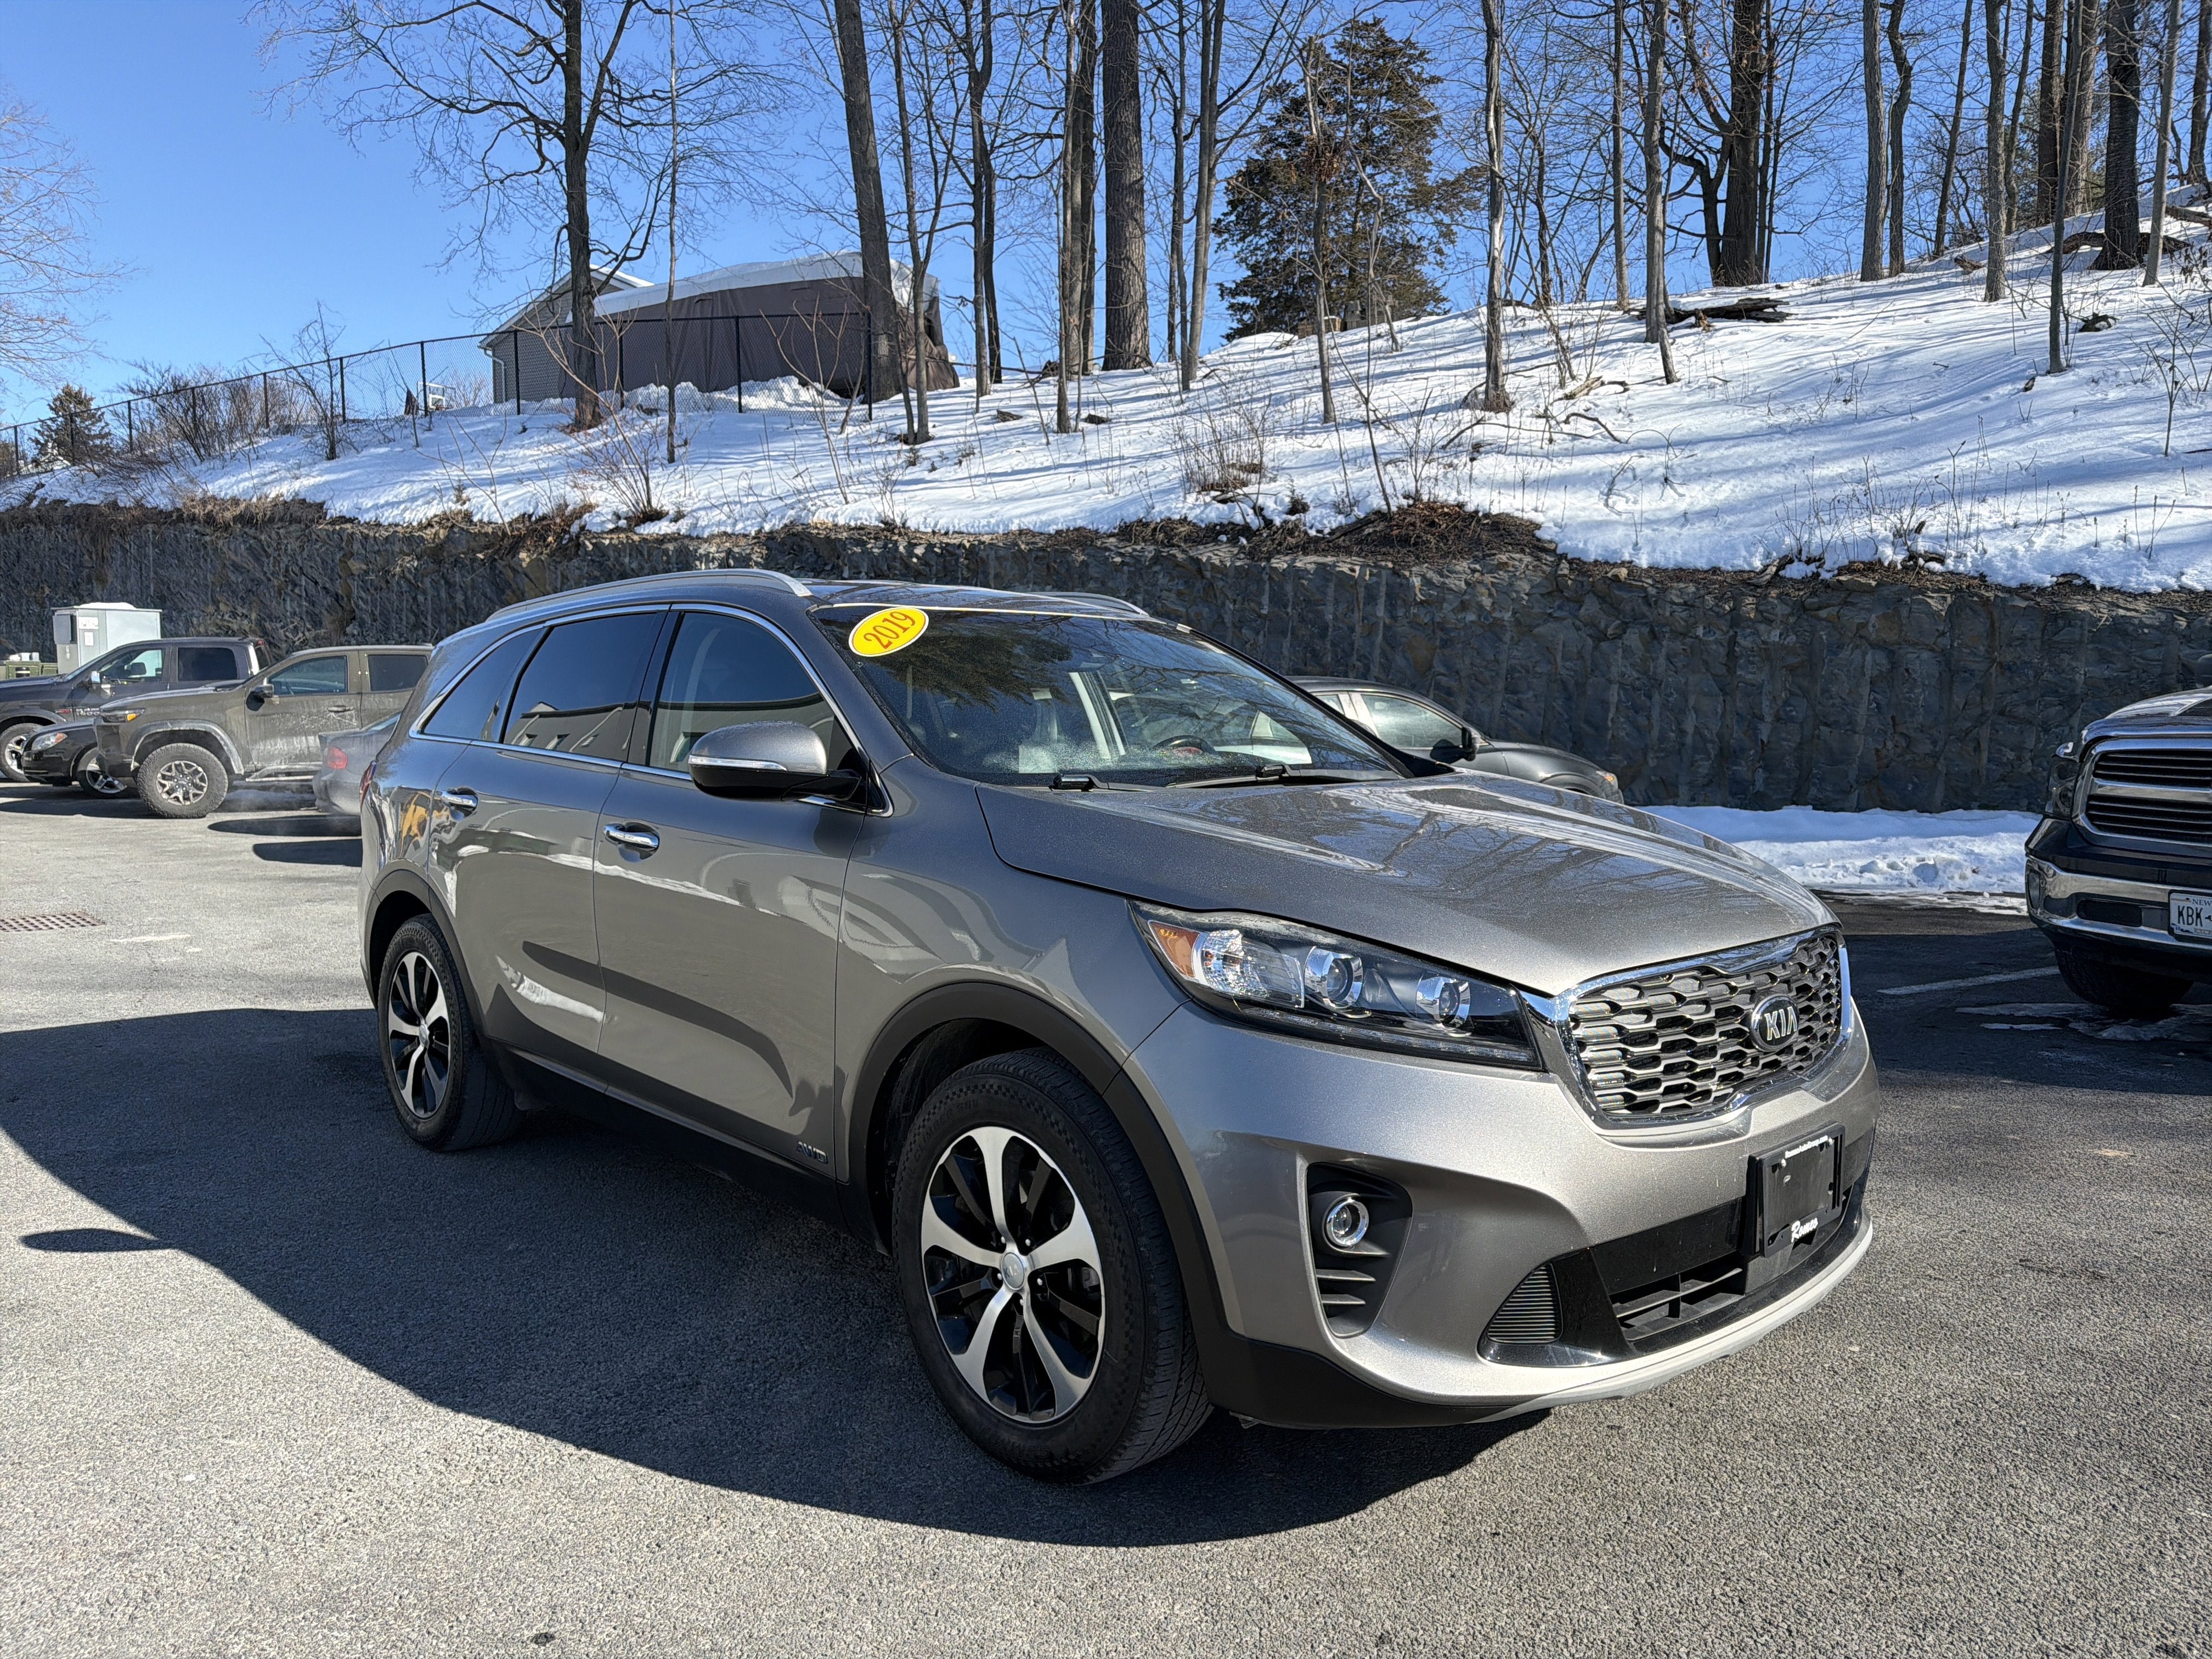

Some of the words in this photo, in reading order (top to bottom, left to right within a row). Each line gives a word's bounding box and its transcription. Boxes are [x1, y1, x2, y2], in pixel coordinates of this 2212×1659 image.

[863, 611, 916, 650] 2019
[2177, 905, 2203, 927] KBK
[1764, 1006, 1798, 1041] KIA
[1791, 1217, 1819, 1243] Romeo
[1003, 1263, 1021, 1279] KIA
